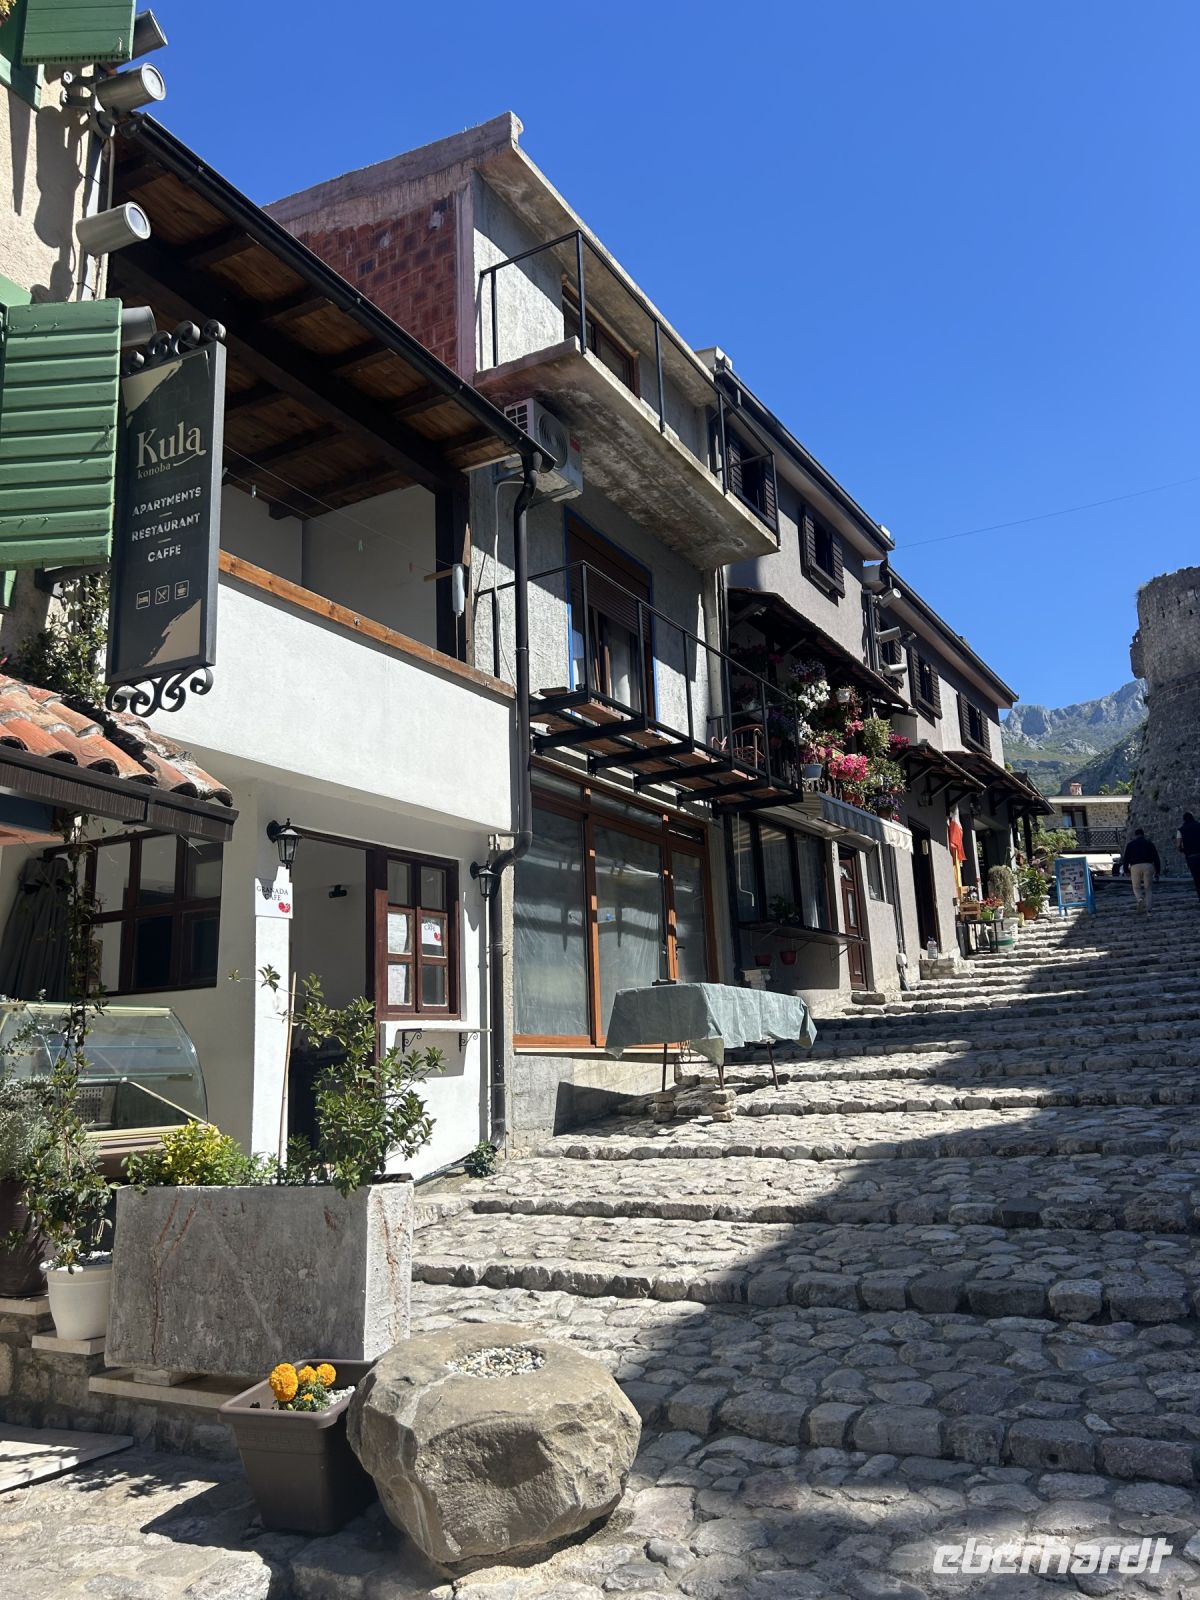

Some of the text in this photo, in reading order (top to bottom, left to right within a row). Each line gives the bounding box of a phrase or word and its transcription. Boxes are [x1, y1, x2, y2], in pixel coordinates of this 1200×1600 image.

[136, 421, 207, 468] Kula
[137, 463, 171, 479] konoba
[132, 487, 201, 516] APARTMENTS
[131, 513, 200, 541] RESTAURANT
[147, 545, 181, 562] CAFFE
[257, 886, 288, 895] GRANADA
